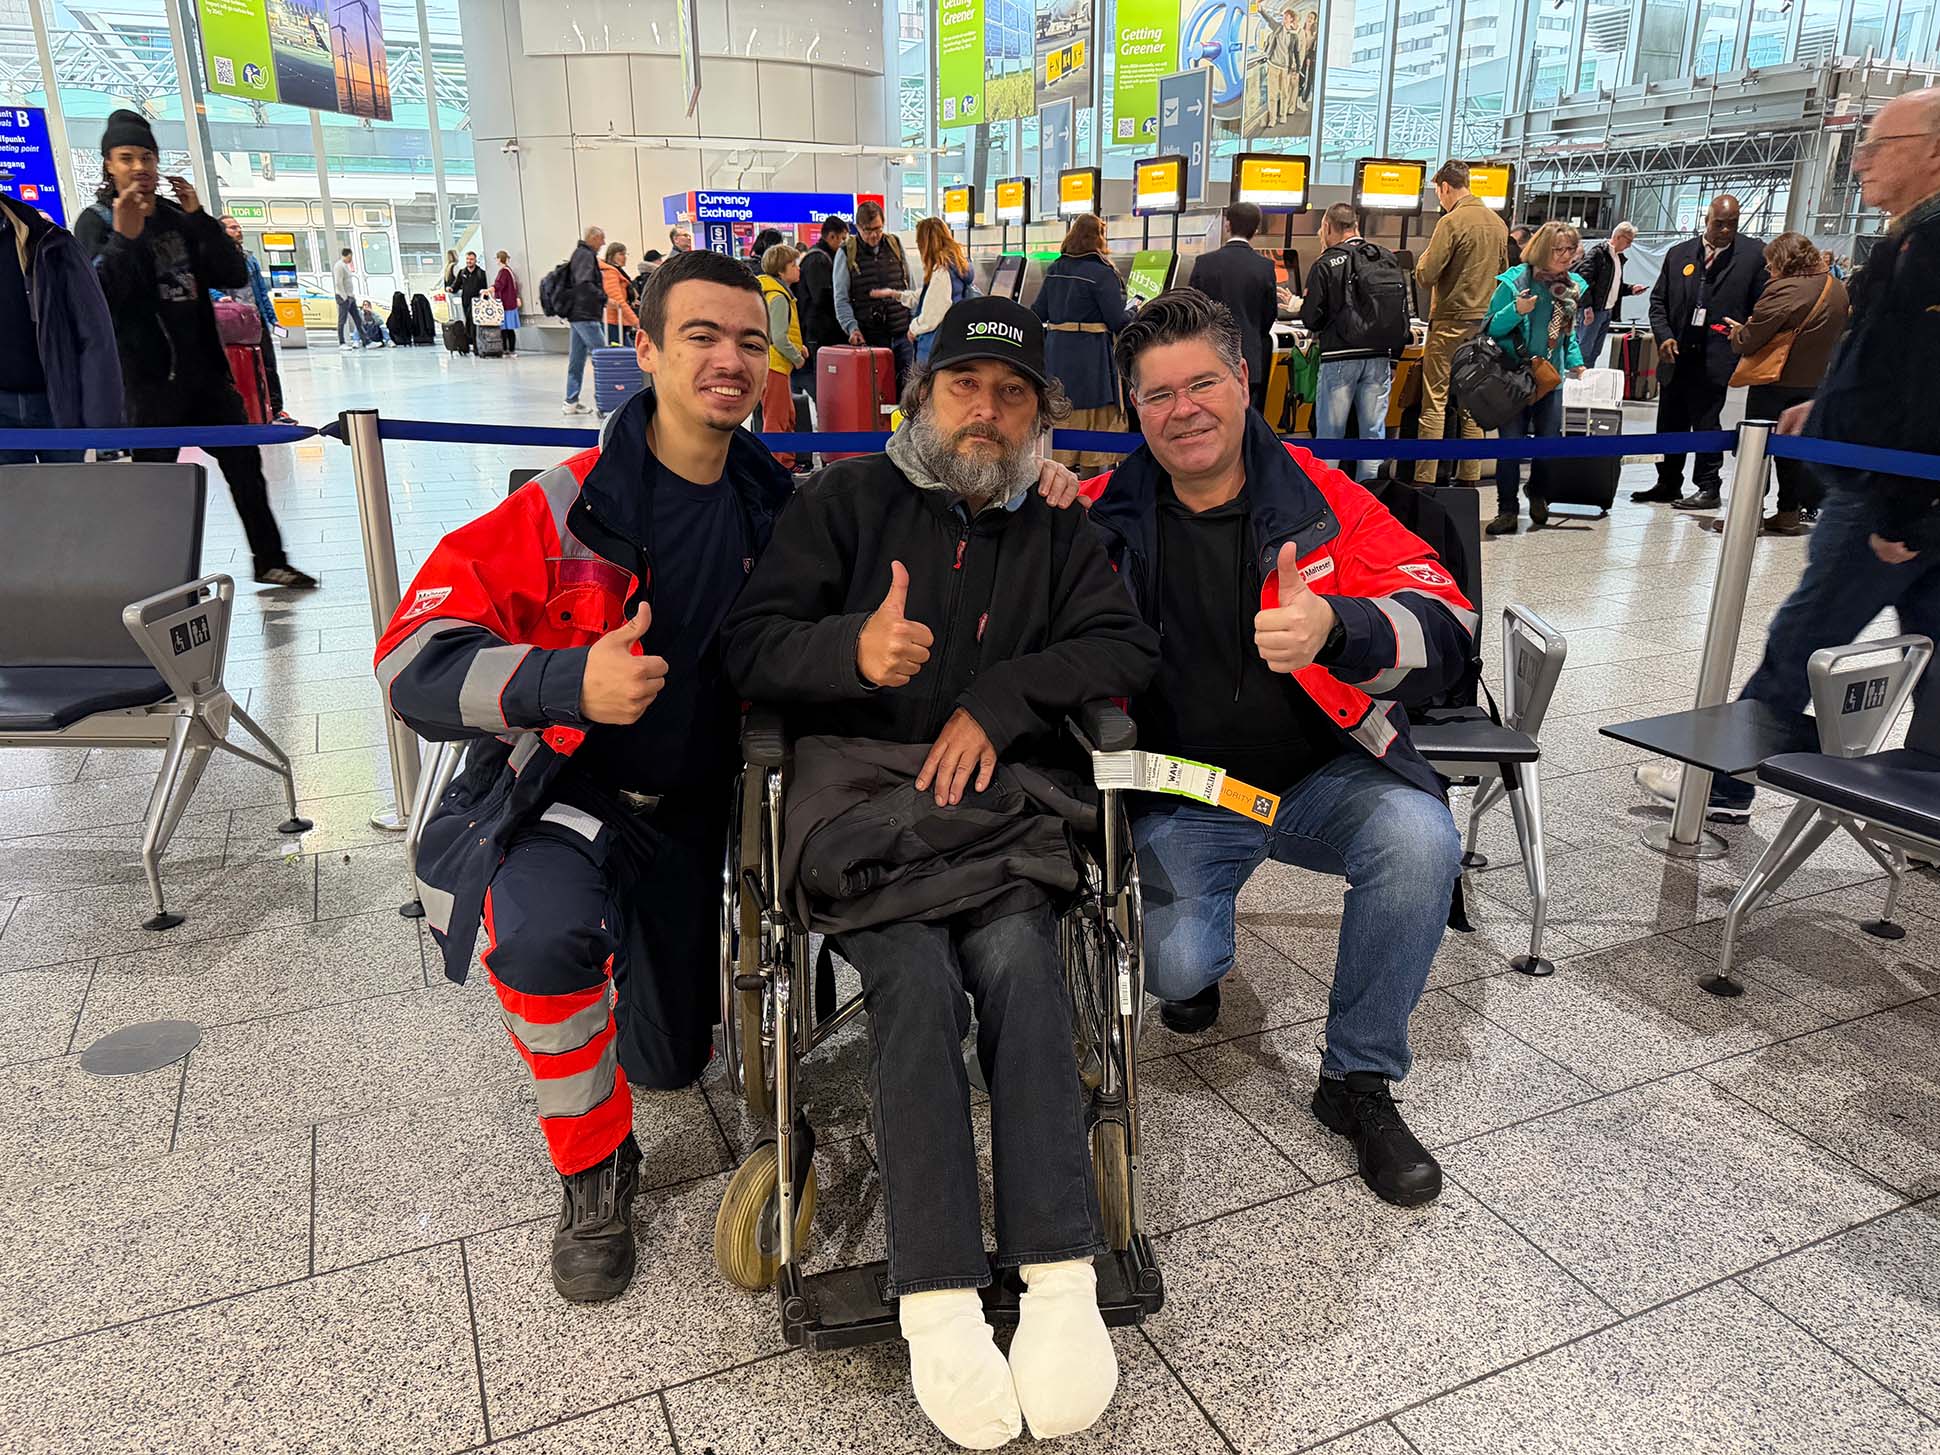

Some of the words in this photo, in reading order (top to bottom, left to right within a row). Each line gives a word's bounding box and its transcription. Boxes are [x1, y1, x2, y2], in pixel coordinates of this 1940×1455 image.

[943, 8, 976, 25] Greener
[1121, 27, 1162, 42] Getting
[1121, 43, 1165, 55] Greener
[16, 110, 30, 127] B
[21, 145, 39, 153] point
[1192, 141, 1201, 166] B
[39, 184, 55, 192] Taxi
[699, 194, 750, 207] Currency
[233, 207, 250, 217] TOR
[699, 207, 753, 220] Exchange
[1330, 255, 1348, 268] RO
[966, 322, 1023, 342] SORDIN
[1168, 762, 1178, 782] WAW
